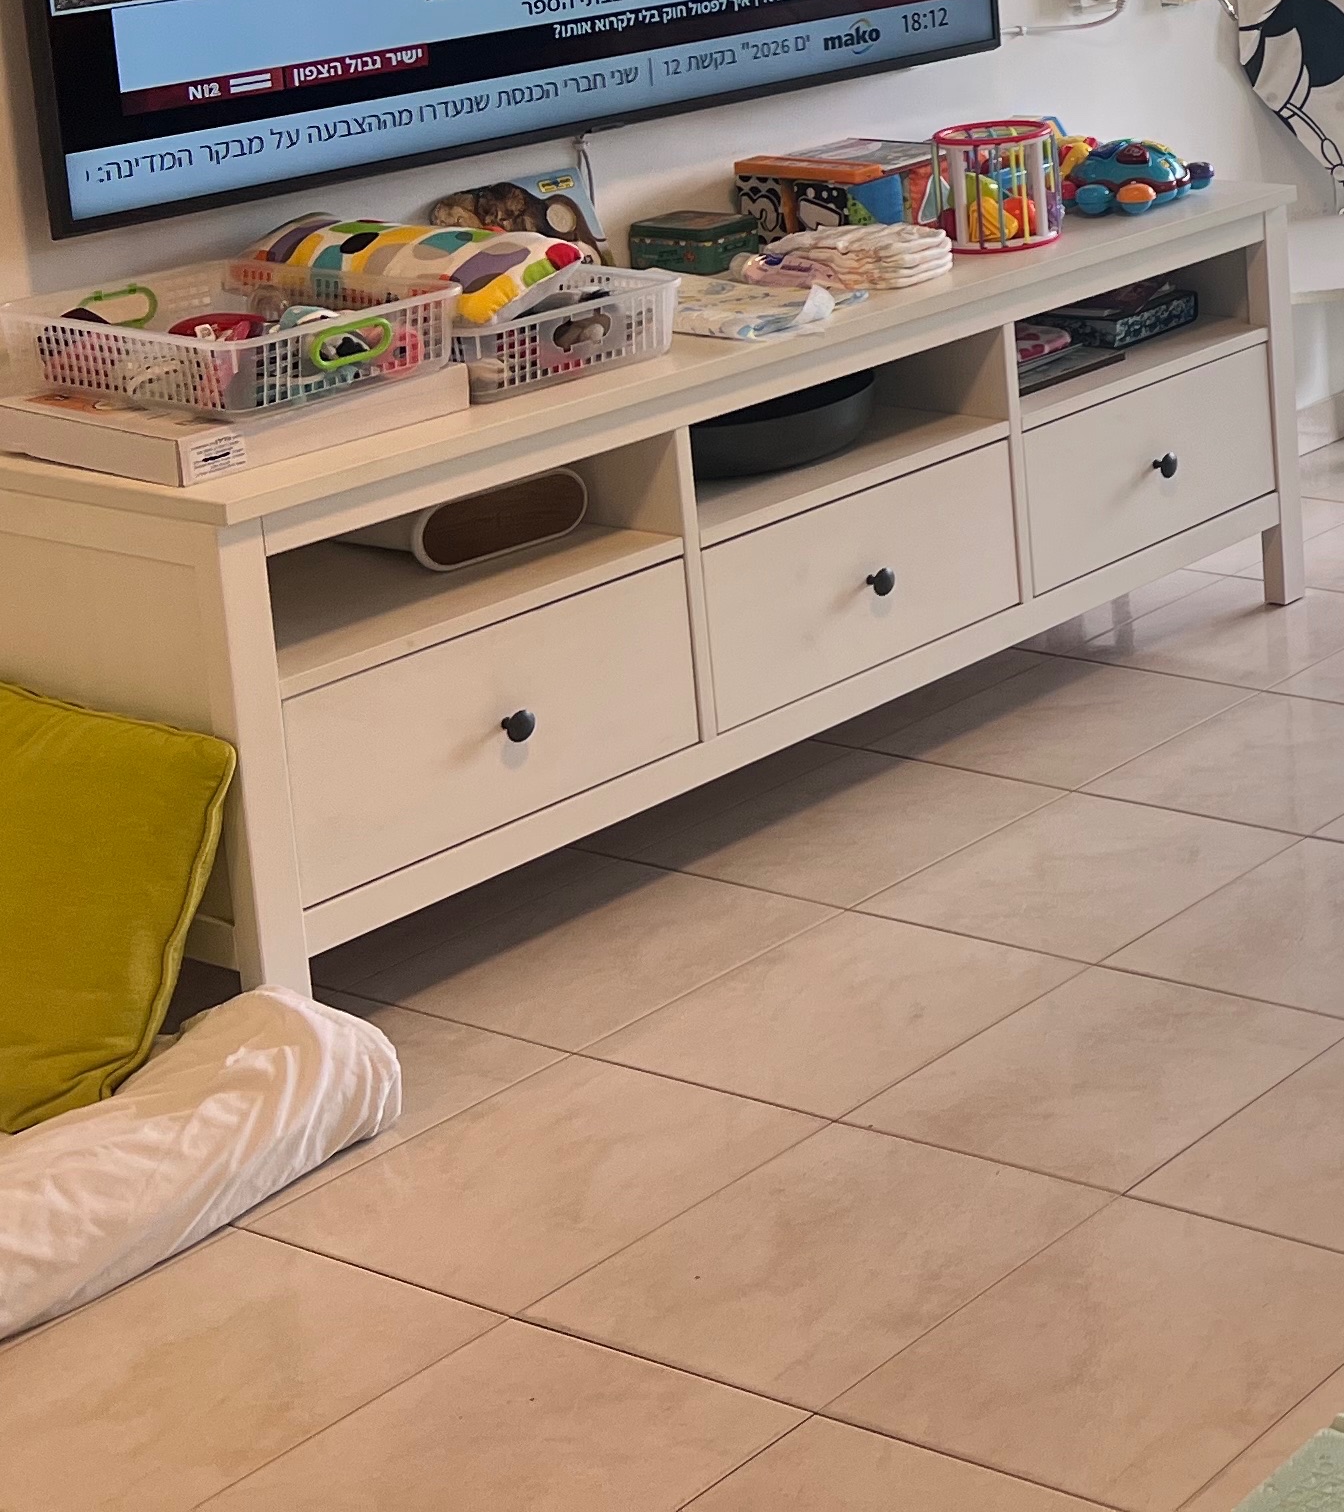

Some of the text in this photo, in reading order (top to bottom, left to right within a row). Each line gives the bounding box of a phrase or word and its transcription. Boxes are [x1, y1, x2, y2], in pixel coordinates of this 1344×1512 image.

[638, 10, 660, 24] בלי
[662, 5, 687, 24] חוק
[688, 0, 728, 18] לפסול
[552, 20, 593, 39] אותו?
[594, 13, 635, 32] לקרוא
[901, 7, 949, 34] 18:12
[823, 25, 881, 52] mako
[293, 48, 423, 86] ישיר גבול הצפון
[663, 58, 682, 77] 12
[686, 48, 738, 72] בקשת
[563, 73, 607, 94] חברי
[610, 66, 639, 86] שני
[188, 83, 222, 101] N12
[496, 81, 559, 109] הכנסת
[418, 94, 490, 123] שנעדרו
[307, 106, 414, 145] מההצבעה
[200, 135, 264, 164] מבקר
[270, 127, 300, 150] על
